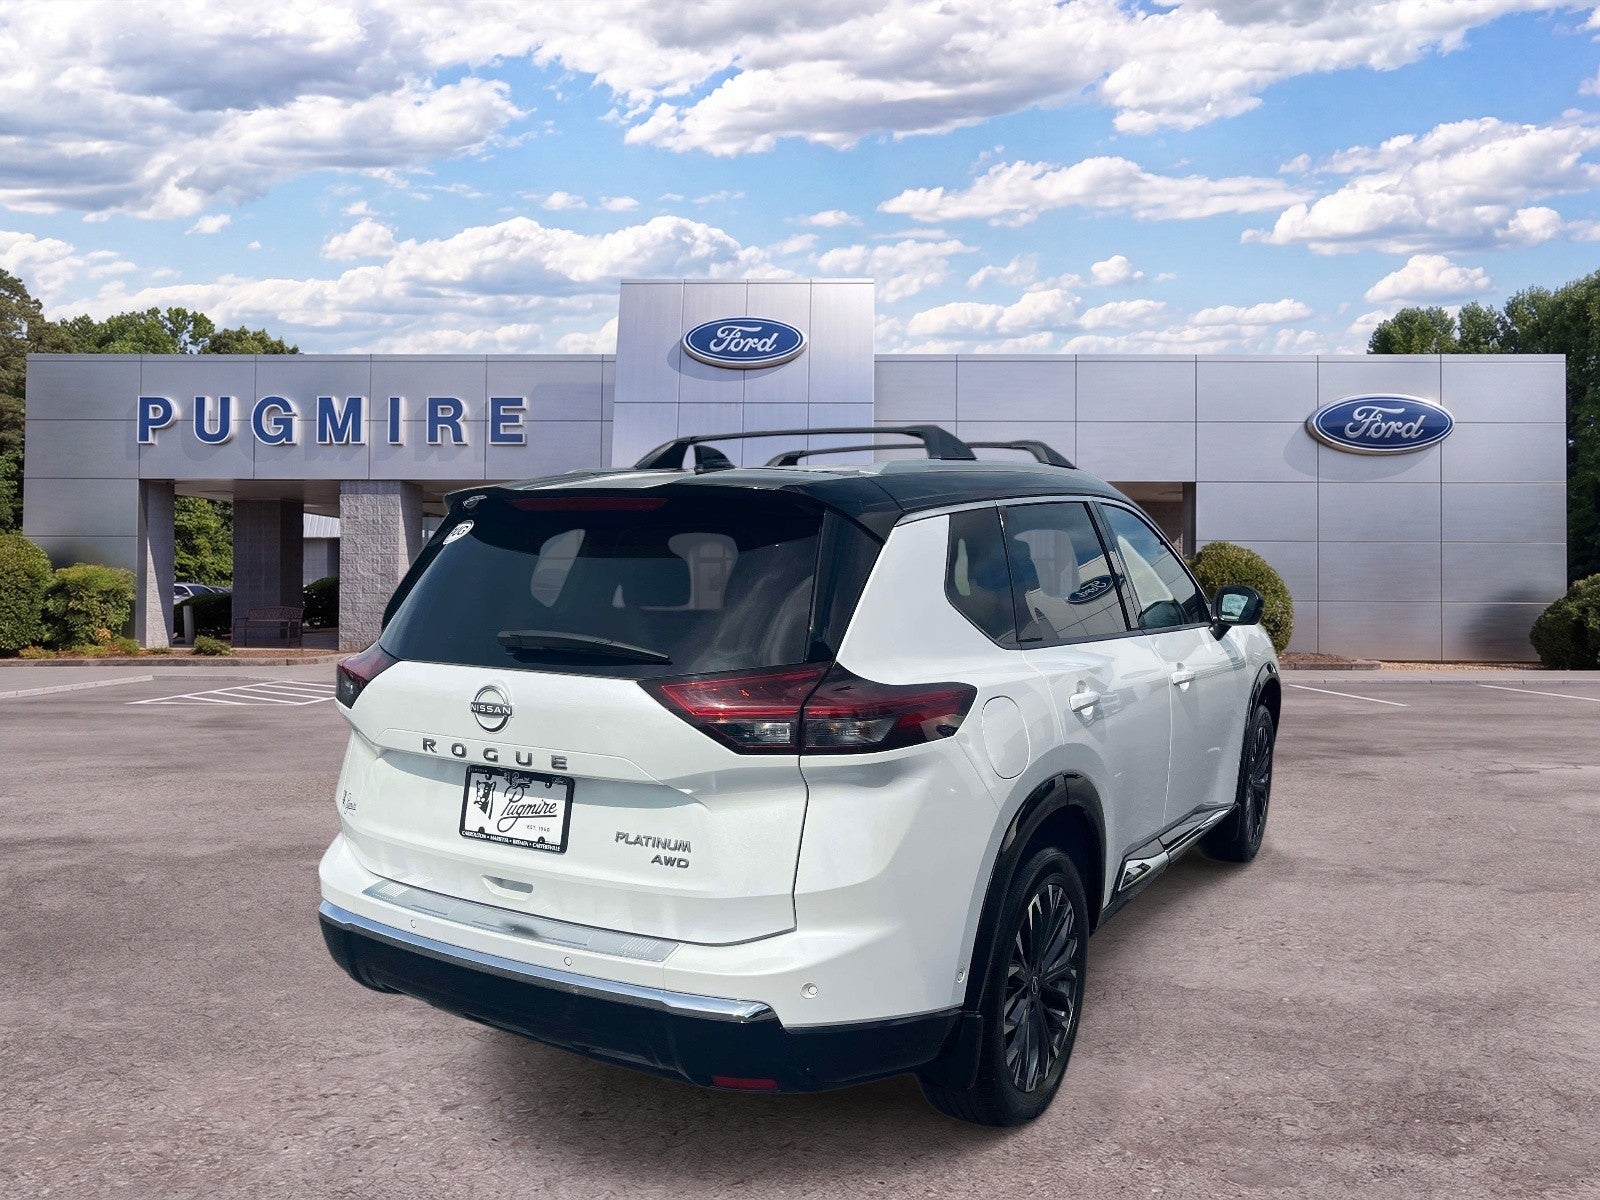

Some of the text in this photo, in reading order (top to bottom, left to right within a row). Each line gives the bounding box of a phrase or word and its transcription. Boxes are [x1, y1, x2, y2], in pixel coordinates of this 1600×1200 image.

[709, 325, 779, 352] Ford
[137, 396, 527, 445] PUGMIRE
[1344, 405, 1426, 439] Ford
[470, 703, 511, 715] NISSAN
[422, 737, 569, 770] ROGUE
[497, 784, 557, 832] Pugmire
[615, 831, 692, 853] PLATINUM
[650, 854, 690, 869] AWD
